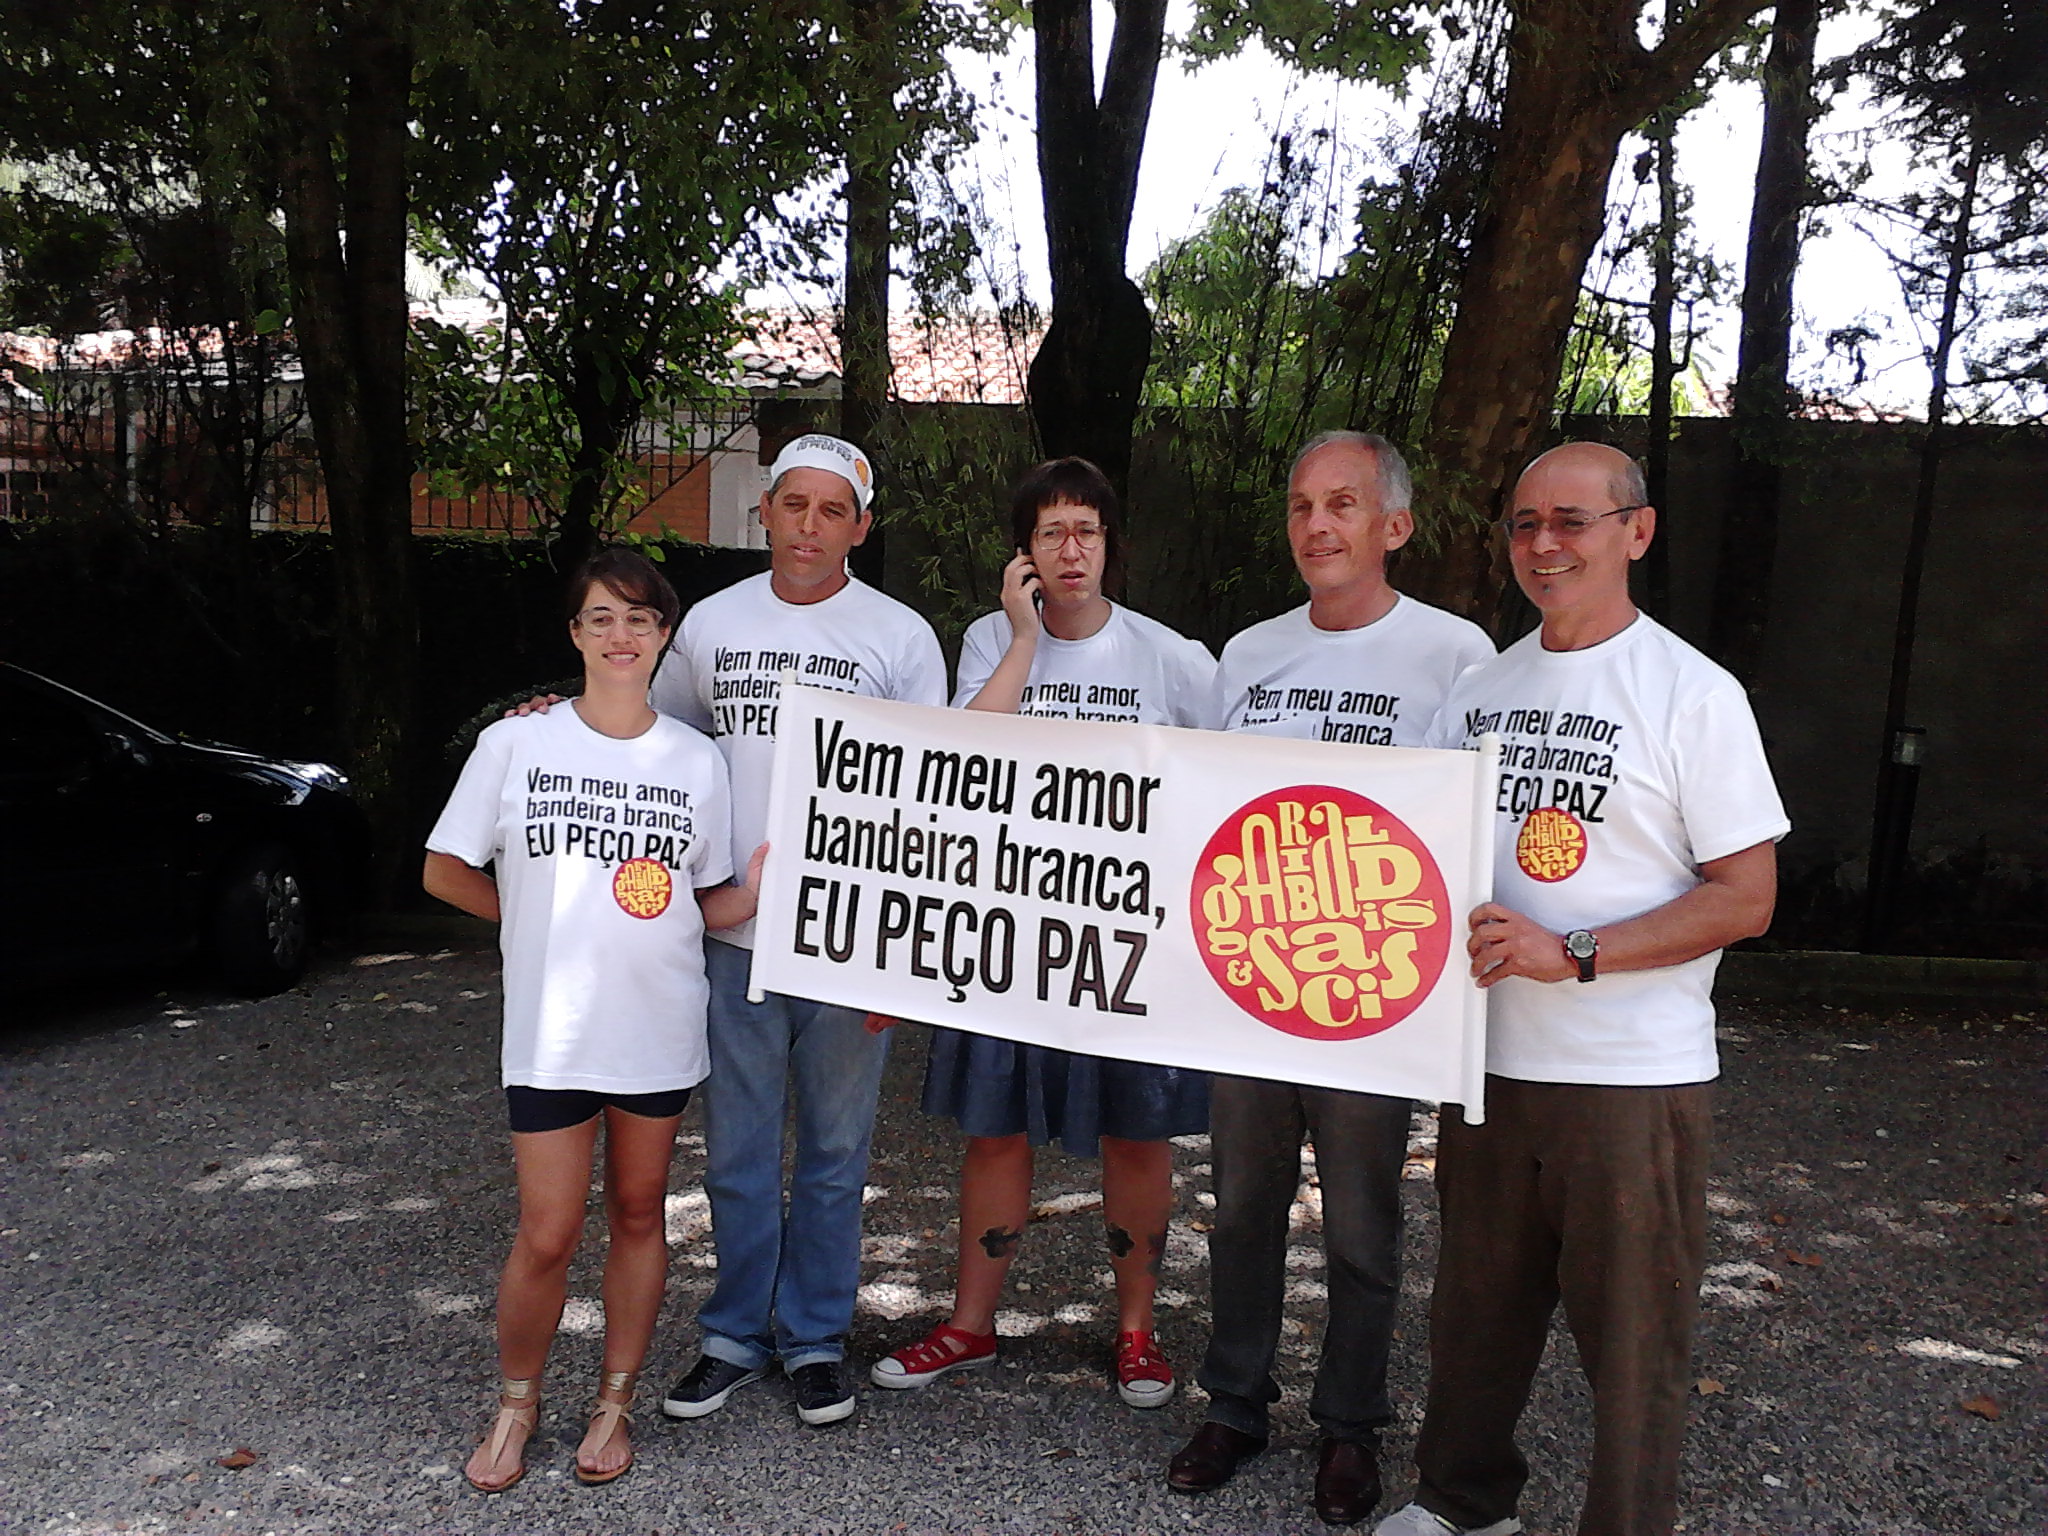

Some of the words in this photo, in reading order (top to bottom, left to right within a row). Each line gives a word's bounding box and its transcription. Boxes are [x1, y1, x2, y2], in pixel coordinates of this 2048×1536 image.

[715, 647, 752, 673] Vem
[757, 651, 801, 673] meu
[805, 654, 860, 686] amor,
[1039, 682, 1081, 704] meu
[1087, 685, 1141, 711] amor,
[1247, 684, 1283, 710] Vem
[1286, 687, 1333, 712] meu
[1337, 691, 1400, 723] amor,
[1465, 708, 1502, 738] Vem
[1504, 708, 1554, 735] meu
[1556, 711, 1622, 752] amor,
[814, 717, 904, 799] Vem
[916, 749, 1017, 814] meu
[1030, 763, 1160, 835] amor
[1538, 739, 1619, 785] branca,
[527, 766, 573, 793] Vem
[581, 777, 628, 800] meu
[636, 783, 693, 813] amor,
[1496, 773, 1543, 823] EÇO
[1551, 778, 1607, 823] PAZ
[526, 796, 616, 823] bandeira
[624, 803, 696, 840] branca,
[525, 822, 555, 858] EU
[566, 823, 634, 869] PEÇO
[644, 833, 690, 871] PAZ
[804, 795, 978, 888] bandeira
[994, 823, 1165, 931] branca,
[794, 875, 860, 963] EU
[876, 889, 1015, 1004] PEÇO
[1037, 916, 1148, 1017] PAZ
